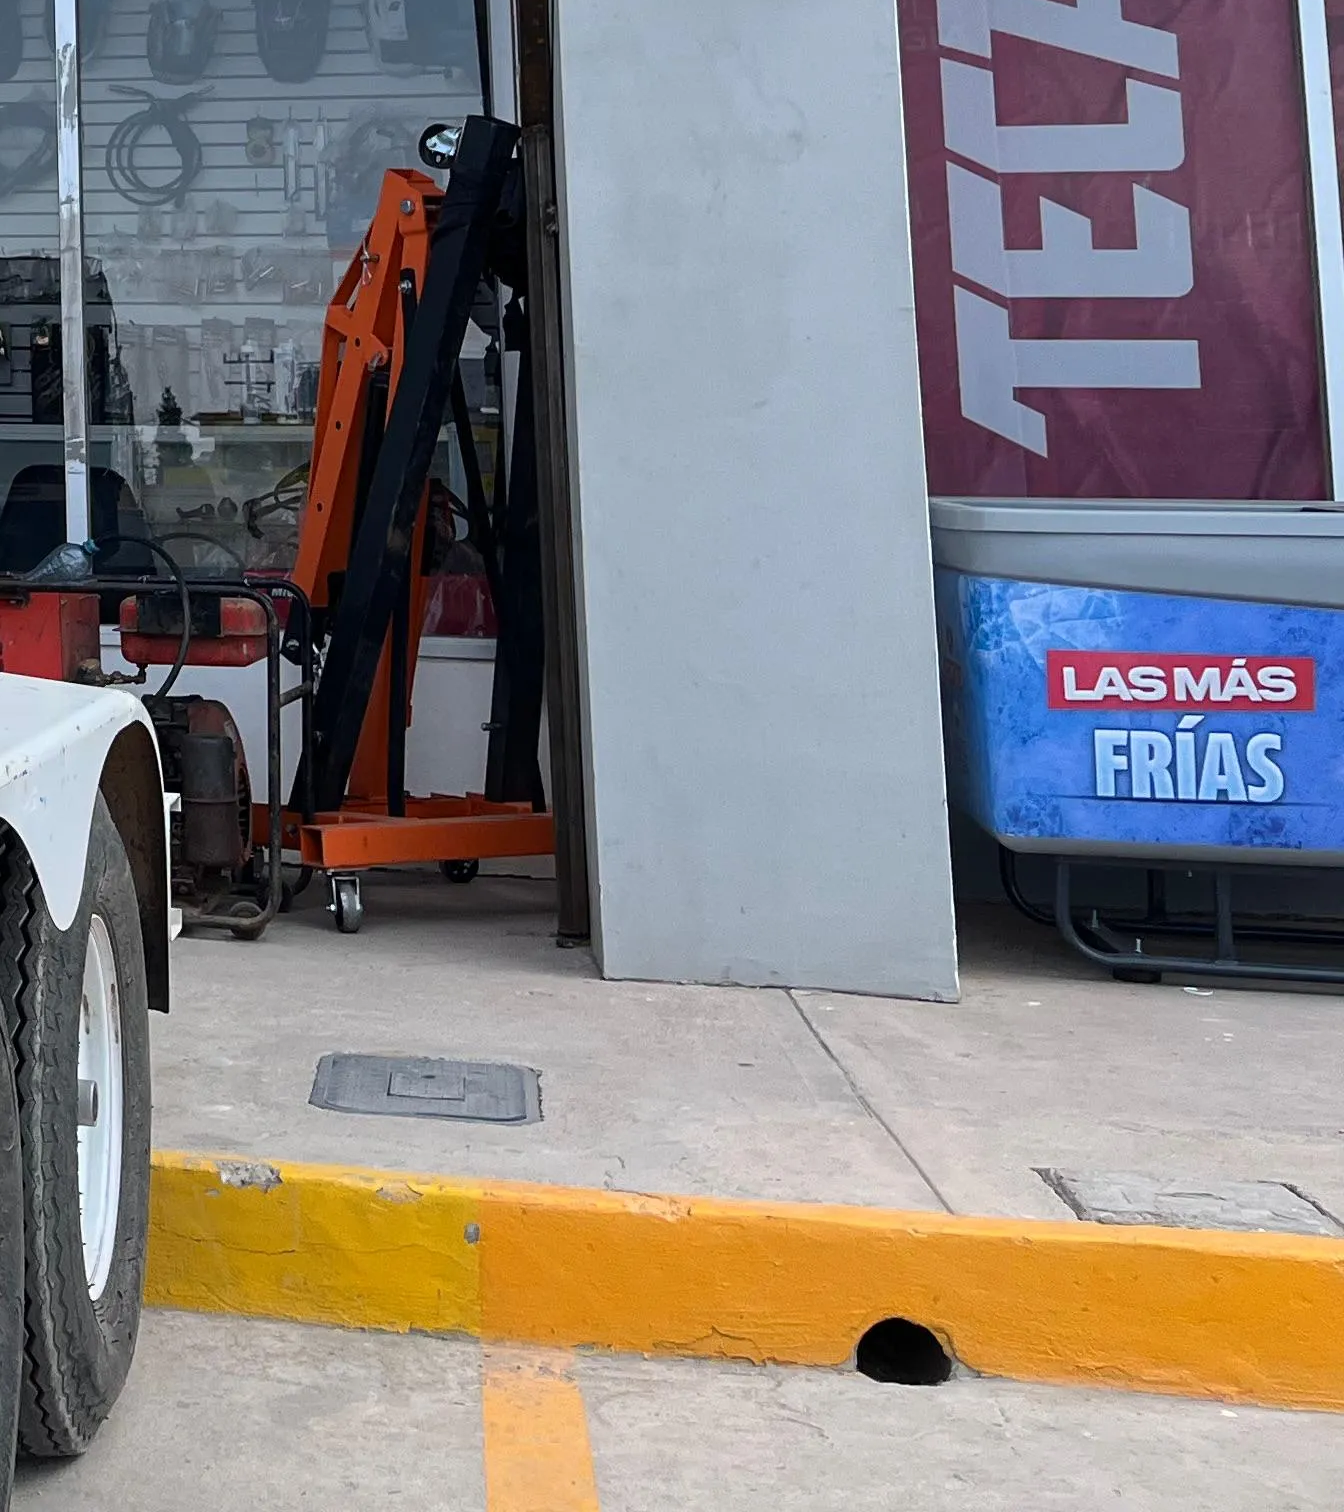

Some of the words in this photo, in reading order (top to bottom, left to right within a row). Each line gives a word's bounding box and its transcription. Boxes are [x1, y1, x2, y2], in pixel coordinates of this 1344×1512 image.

[1062, 665, 1169, 702] LAS
[1174, 657, 1298, 703] MÁS
[1093, 714, 1285, 804] FRÍAS
